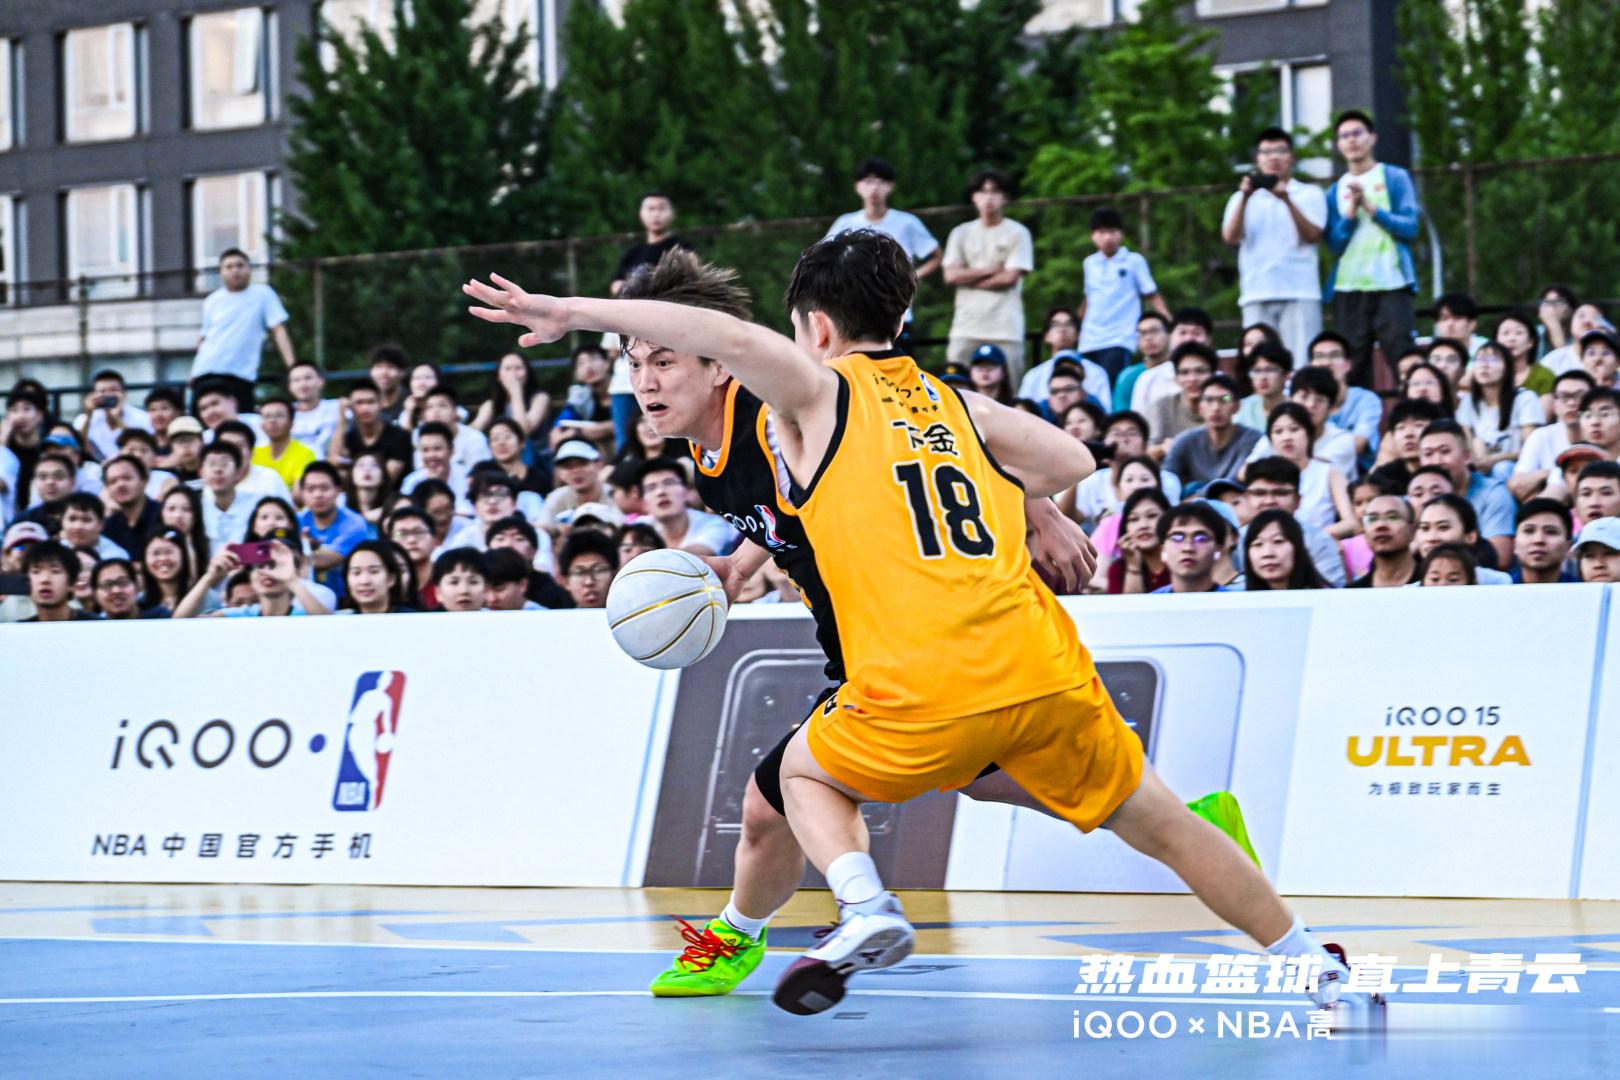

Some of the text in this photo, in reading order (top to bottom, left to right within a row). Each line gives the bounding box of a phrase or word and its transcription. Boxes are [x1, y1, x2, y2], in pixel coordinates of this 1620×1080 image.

[893, 458, 996, 560] 18
[1384, 706, 1502, 727] iQOO 15
[110, 718, 292, 770] iQOO
[1346, 735, 1532, 767] ULTRA
[91, 833, 373, 859] NBA 中国官方手机
